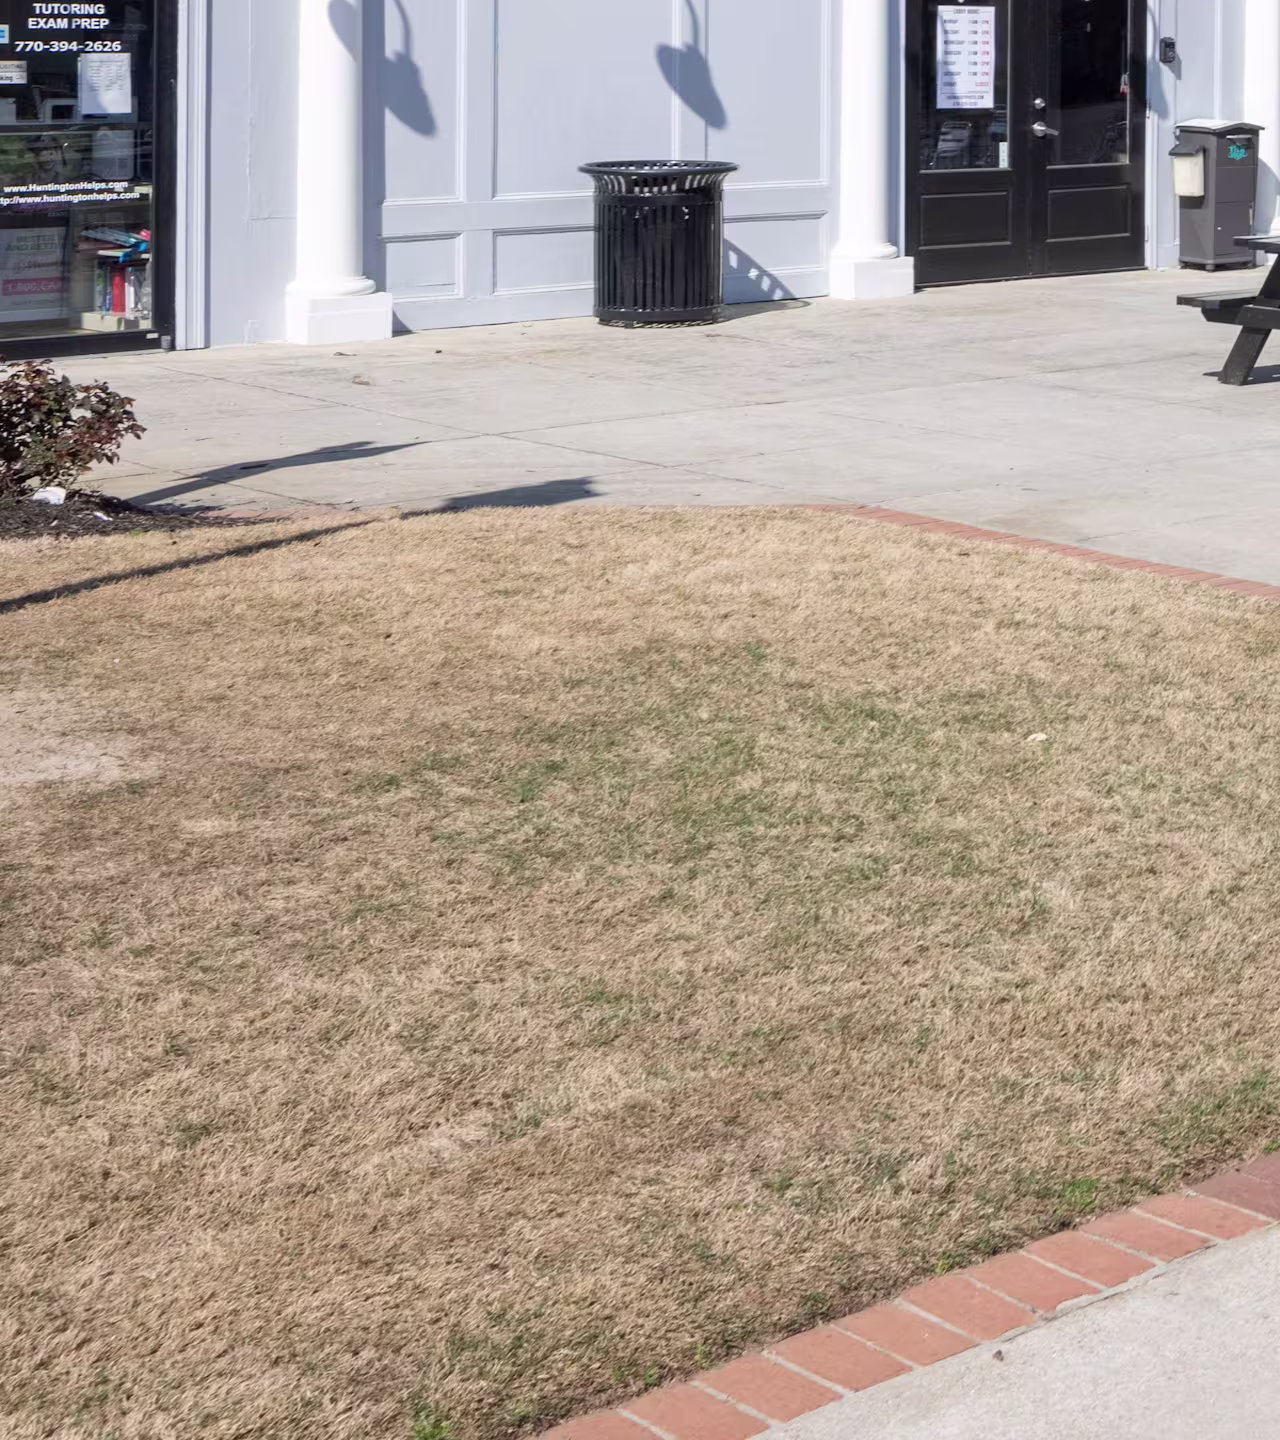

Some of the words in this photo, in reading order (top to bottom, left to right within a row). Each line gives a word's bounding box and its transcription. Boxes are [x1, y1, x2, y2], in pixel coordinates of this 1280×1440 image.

[32, 3, 106, 15] TUTORING
[28, 17, 68, 29] EXAM
[71, 17, 110, 29] PREP
[14, 41, 122, 52] 770-394-2626
[3, 181, 129, 193] www.HuntingtonHelps.com
